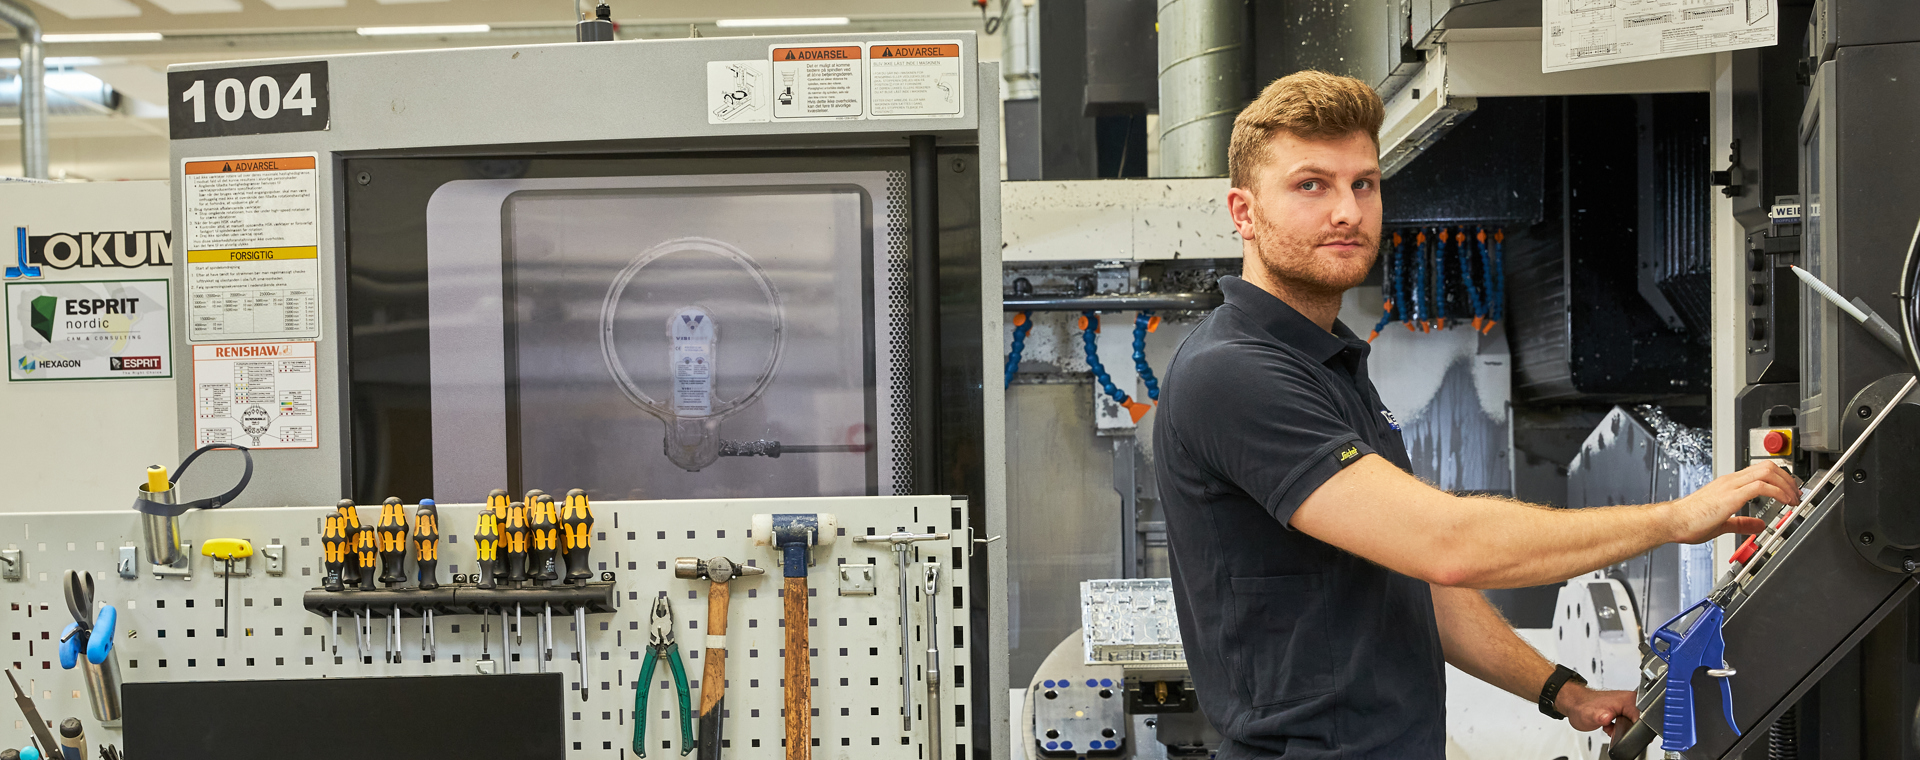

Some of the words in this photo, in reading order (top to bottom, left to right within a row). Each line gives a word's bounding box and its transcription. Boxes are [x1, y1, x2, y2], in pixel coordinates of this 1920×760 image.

[798, 50, 848, 59] ADVARSEL
[895, 47, 944, 56] ADVARSEL
[182, 72, 317, 123] 1004
[235, 161, 279, 171] ADVARSEL
[230, 250, 274, 260] FORSIGTIG
[65, 298, 139, 315] ESPRIT
[66, 318, 109, 329] nordic
[216, 346, 280, 357] RENISHAW
[39, 360, 81, 369] HEXAGON
[123, 358, 159, 368] ESPRIT
